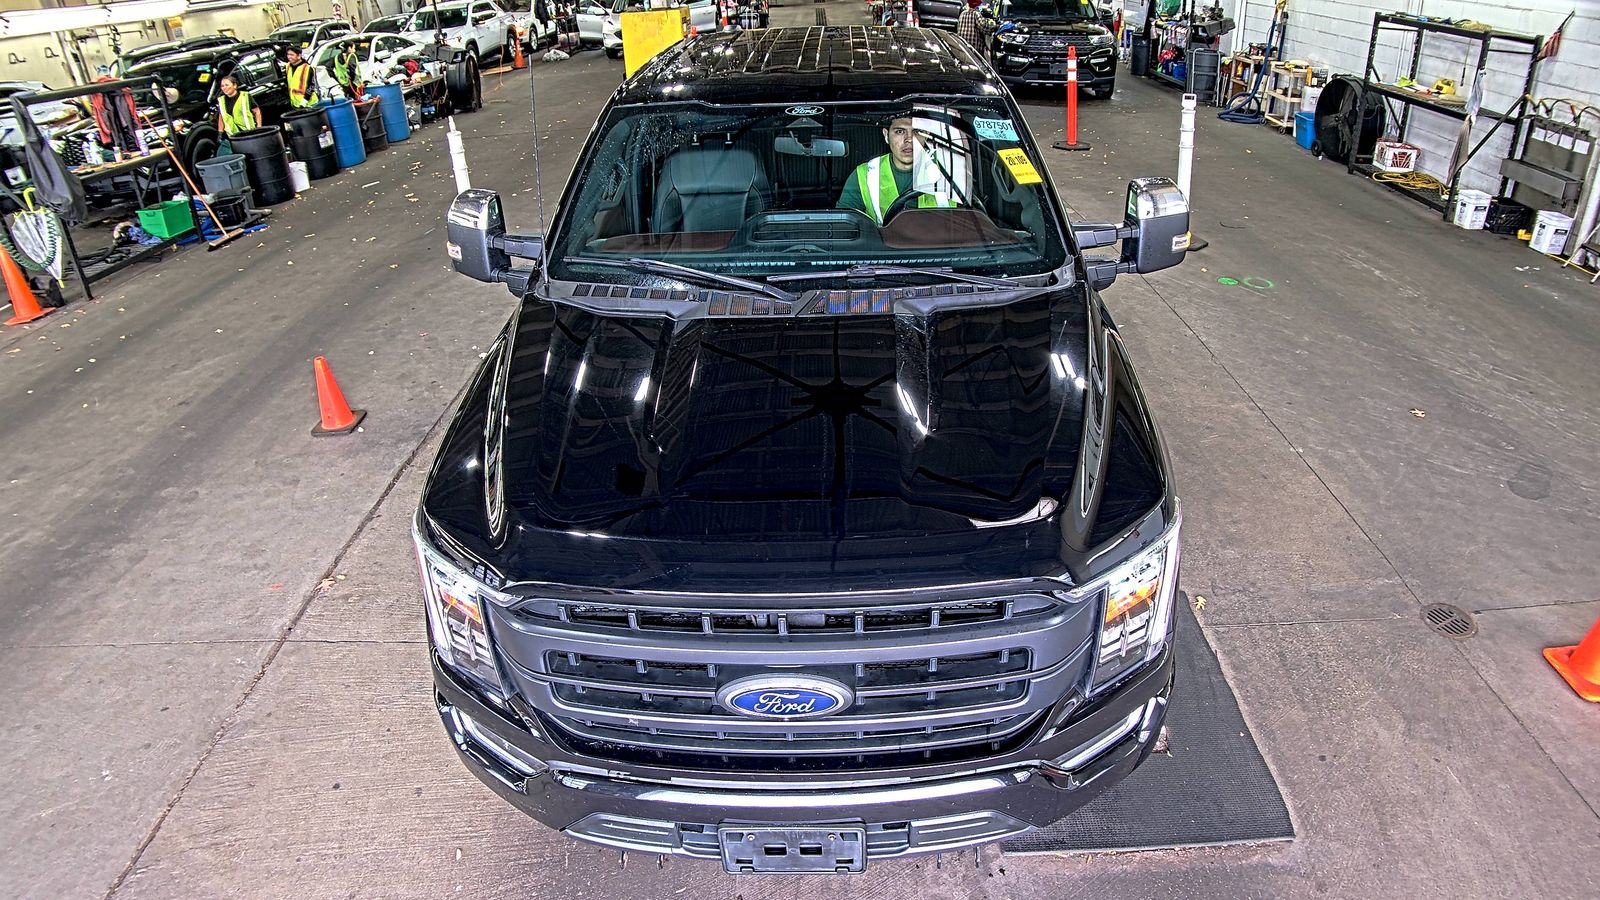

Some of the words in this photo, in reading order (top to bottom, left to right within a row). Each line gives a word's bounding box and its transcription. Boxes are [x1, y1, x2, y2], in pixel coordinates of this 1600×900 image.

[791, 106, 818, 114] Ford
[974, 120, 1013, 131] 9787501
[753, 692, 816, 713] Ford
